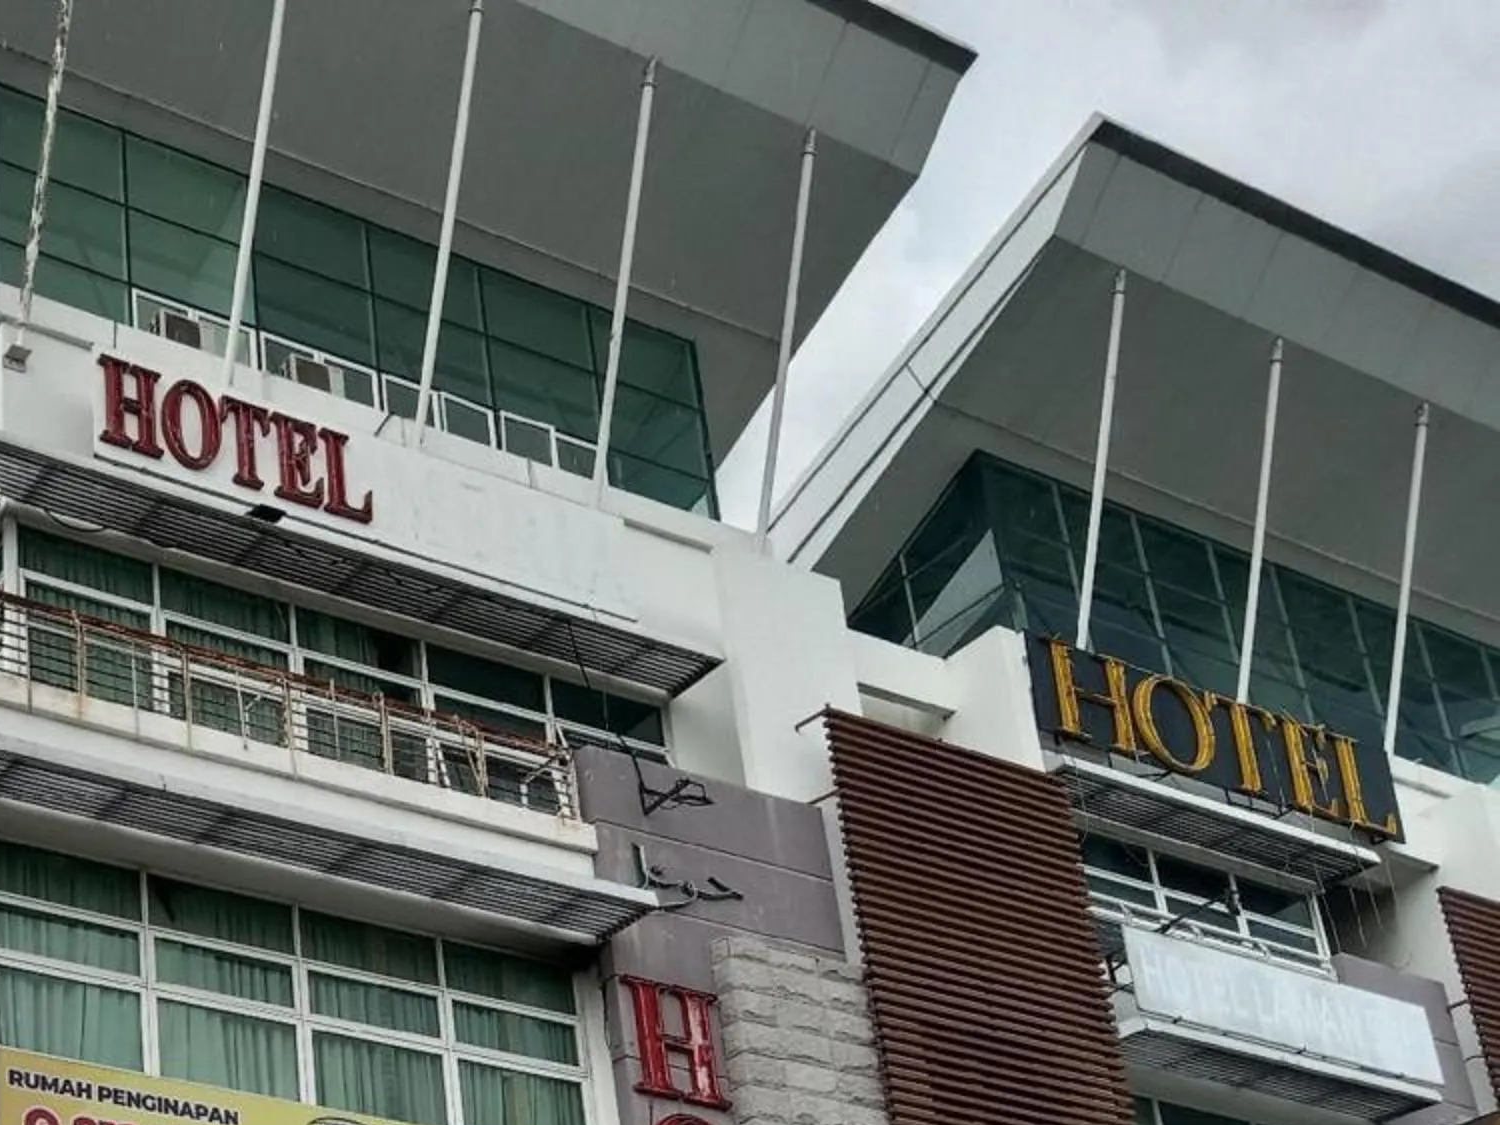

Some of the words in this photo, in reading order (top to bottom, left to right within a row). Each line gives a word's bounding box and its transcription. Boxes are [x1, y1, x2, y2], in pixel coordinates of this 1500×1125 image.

[97, 353, 373, 524] HOTEL
[1048, 634, 1398, 840] HOTEL
[8, 1069, 92, 1100] RUMAH
